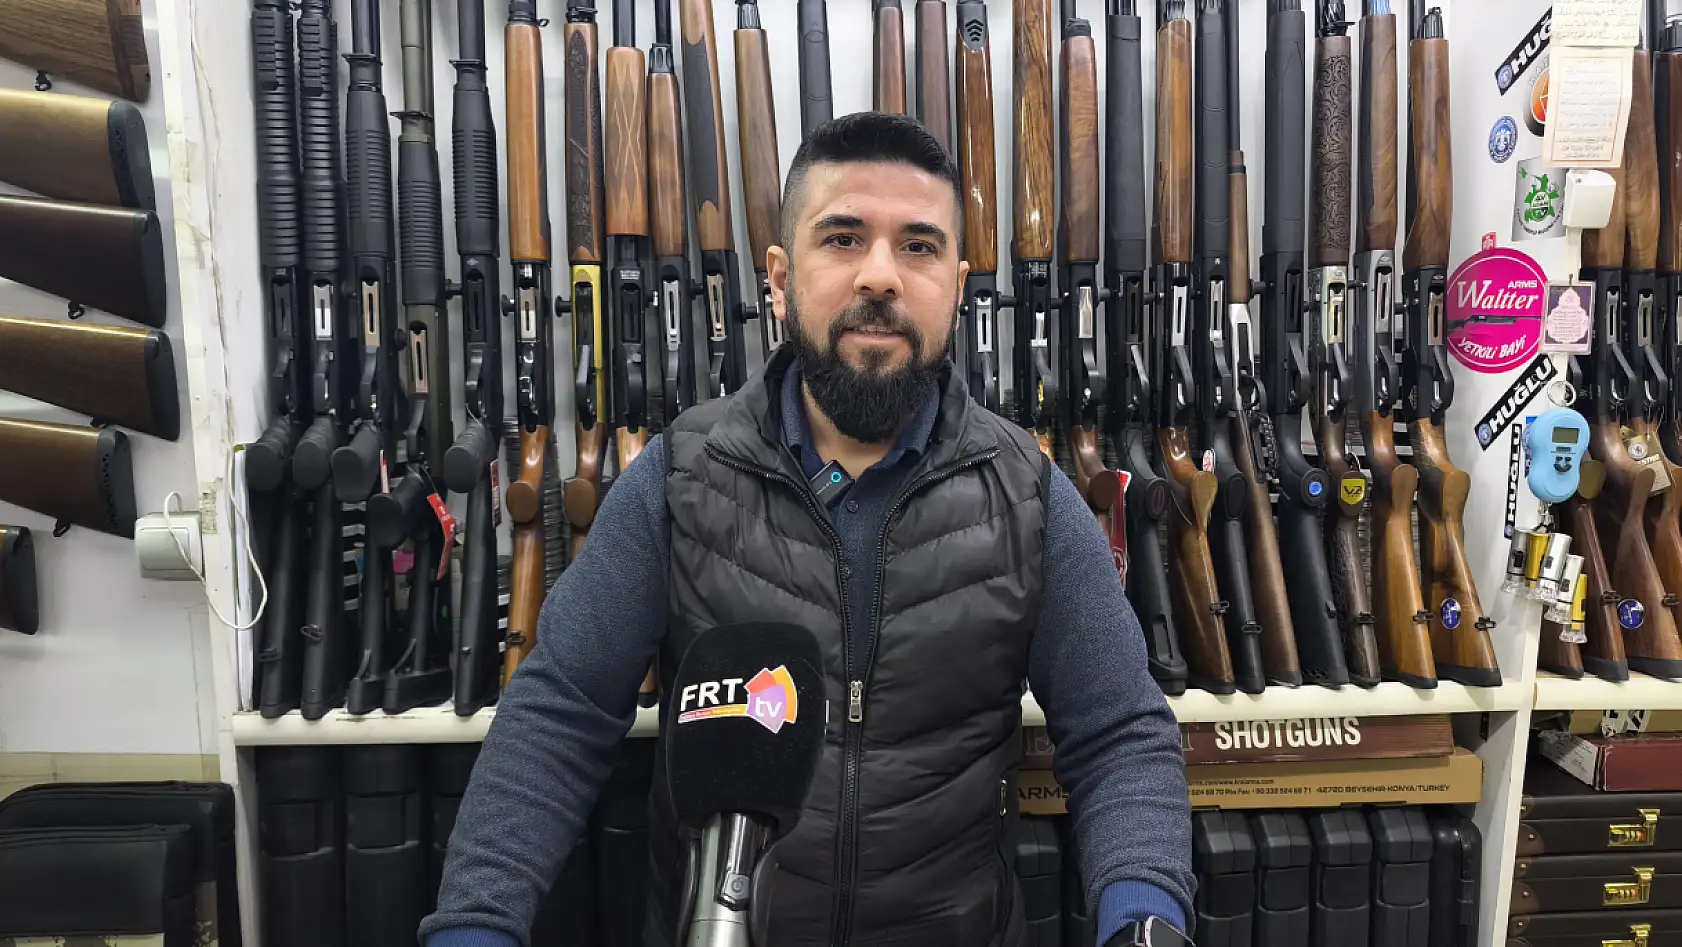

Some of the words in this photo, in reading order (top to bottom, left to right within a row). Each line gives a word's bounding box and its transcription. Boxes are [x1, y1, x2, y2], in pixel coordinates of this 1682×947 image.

[1456, 280, 1539, 310] Waltter
[1508, 280, 1538, 289] ARMS
[1488, 358, 1551, 433] HUĞLU
[680, 678, 743, 712] FRT
[755, 696, 783, 718] tv
[1215, 717, 1361, 750] SHOTGUNS
